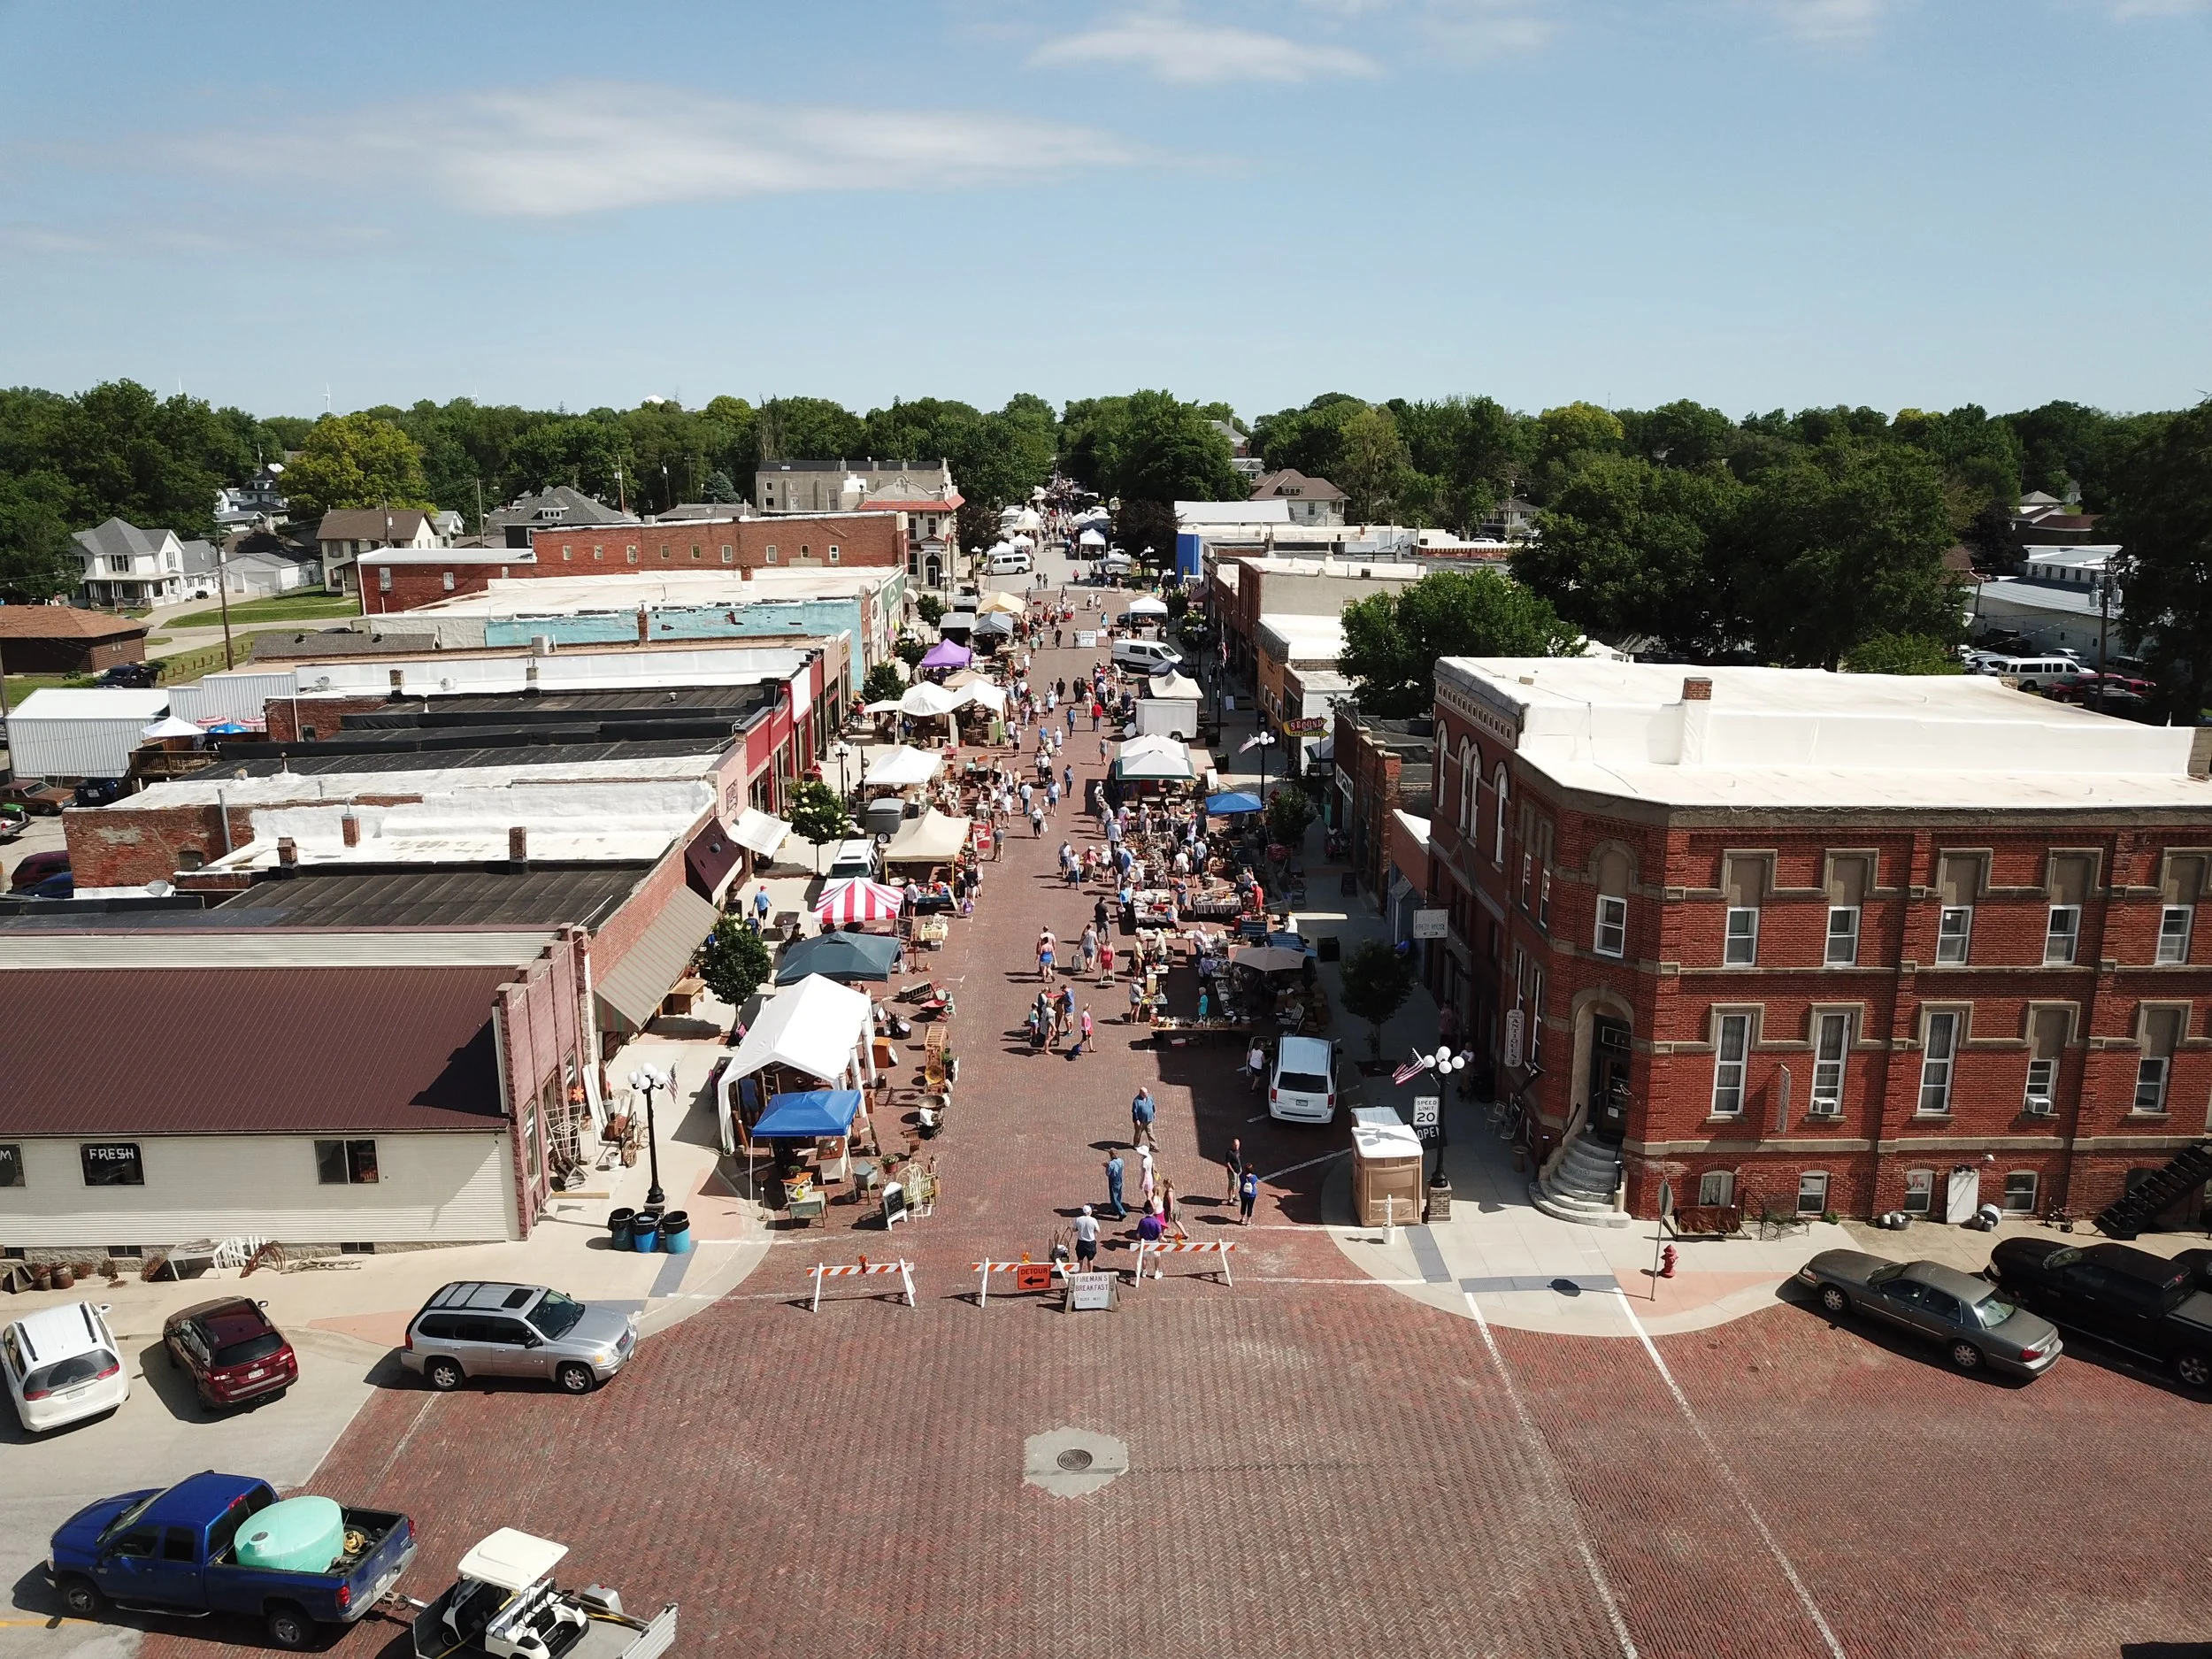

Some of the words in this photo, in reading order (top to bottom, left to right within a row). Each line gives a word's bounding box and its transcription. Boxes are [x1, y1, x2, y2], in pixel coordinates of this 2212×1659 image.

[1290, 719, 1323, 730] SECOND
[1417, 1112, 1435, 1122] 20
[88, 1148, 134, 1161] FRESH
